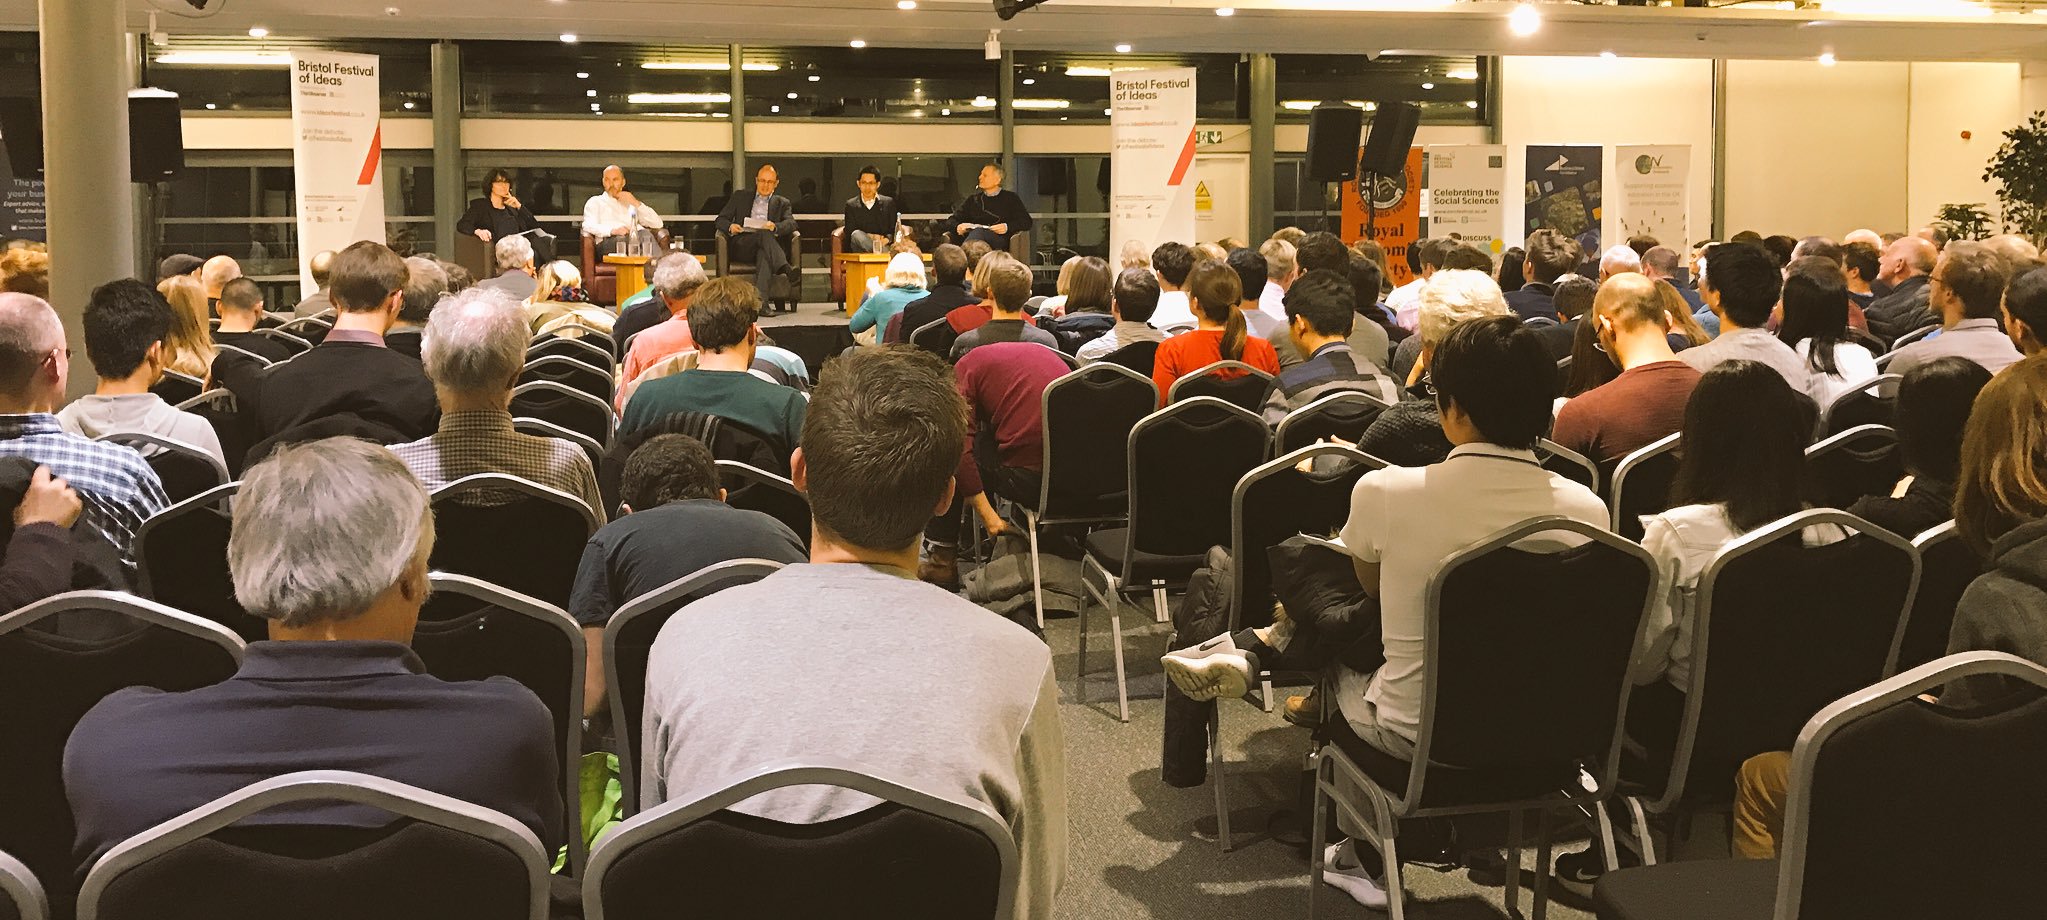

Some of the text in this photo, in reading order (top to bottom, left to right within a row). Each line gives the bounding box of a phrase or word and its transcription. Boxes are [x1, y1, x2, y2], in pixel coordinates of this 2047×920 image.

[298, 59, 374, 77] Bristol Festival
[299, 72, 342, 86] of Ideas
[1116, 78, 1190, 91] Bristol Festival
[1115, 91, 1157, 101] of Ideas
[7, 191, 27, 200] your
[1434, 188, 1500, 198] Celebrating the
[1434, 197, 1499, 205] Social Sciences
[1356, 200, 1391, 218] FOUDED
